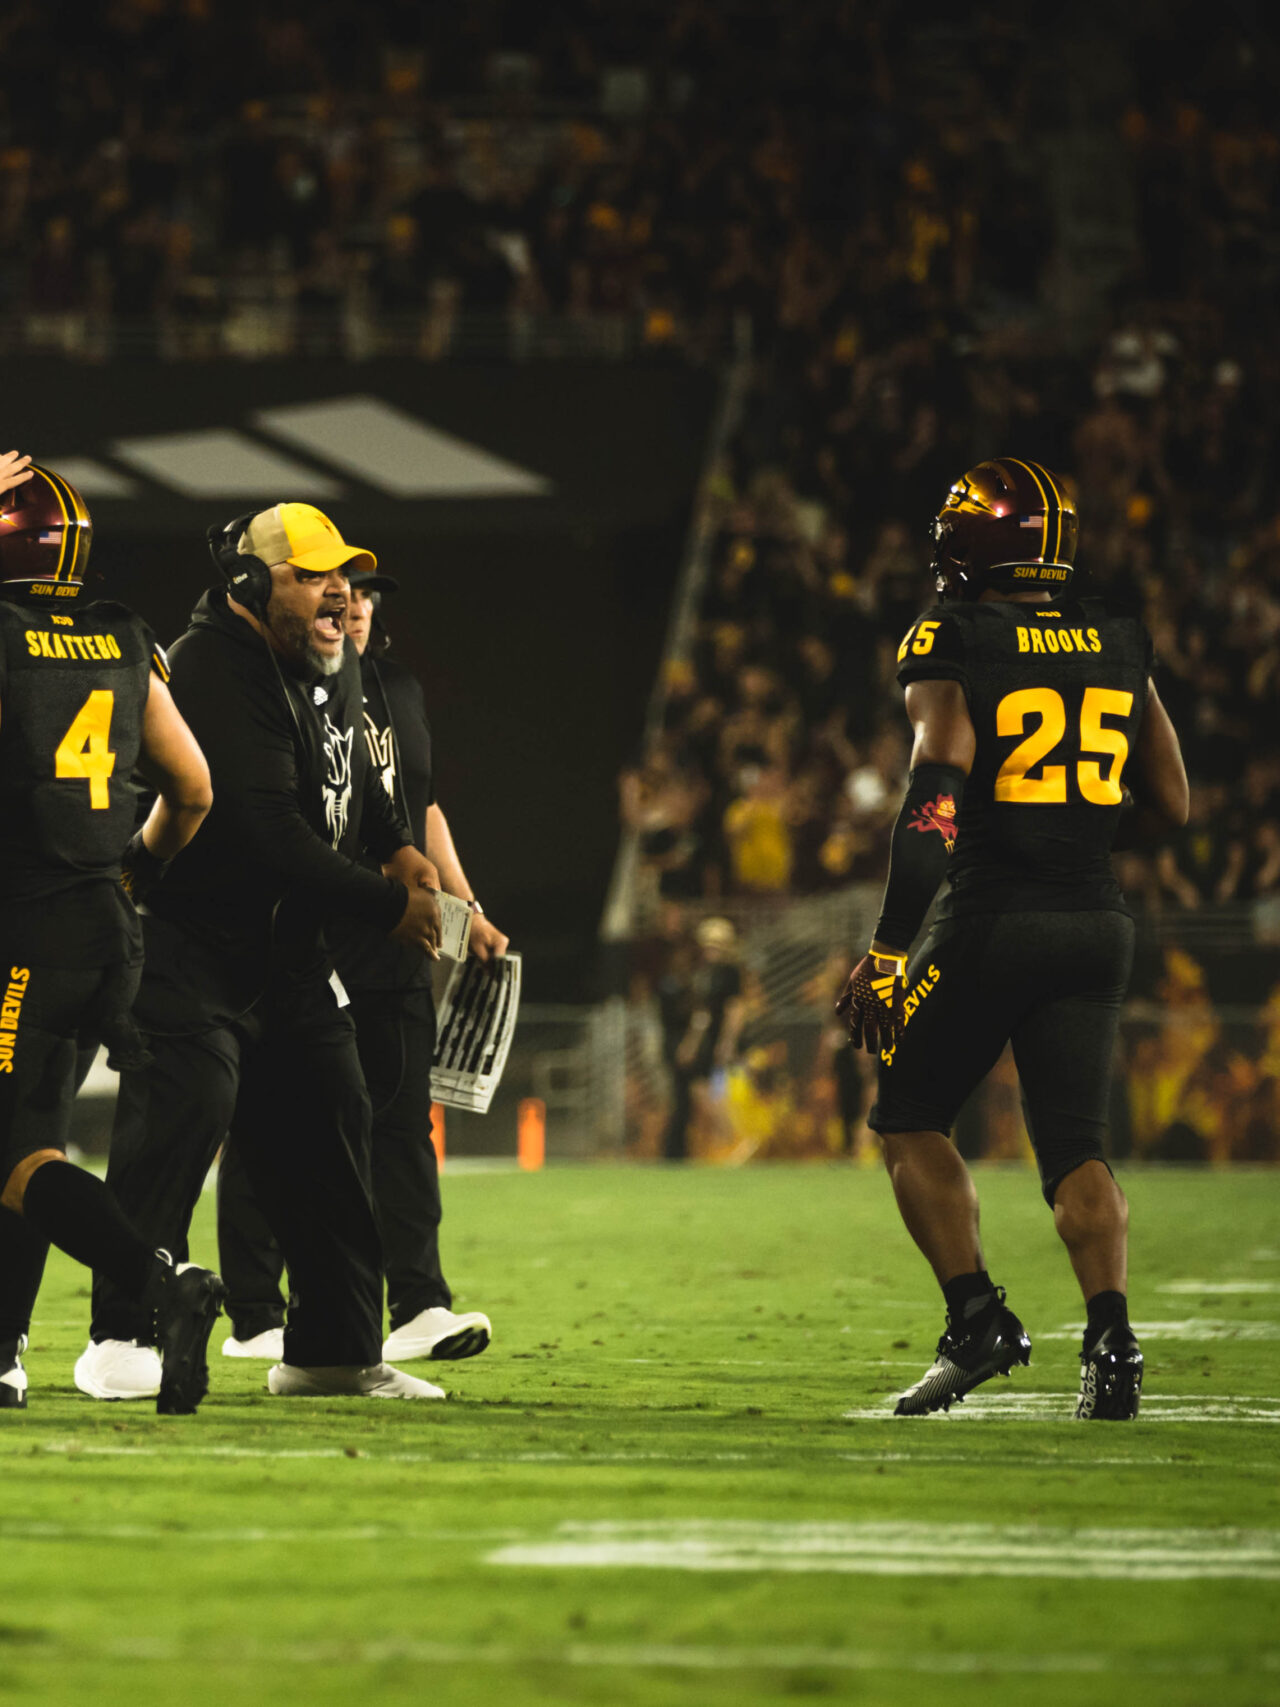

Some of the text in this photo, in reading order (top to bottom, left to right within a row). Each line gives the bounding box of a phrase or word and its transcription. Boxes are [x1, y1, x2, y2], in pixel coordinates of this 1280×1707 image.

[1013, 567, 1068, 581] SUN DEVILS
[29, 584, 55, 596] SUN
[25, 630, 122, 659] SKATTEBO
[1016, 626, 1102, 654] BROOKS
[54, 689, 116, 810] 4
[994, 687, 1134, 806] 25
[0, 965, 31, 1030] DEVILS
